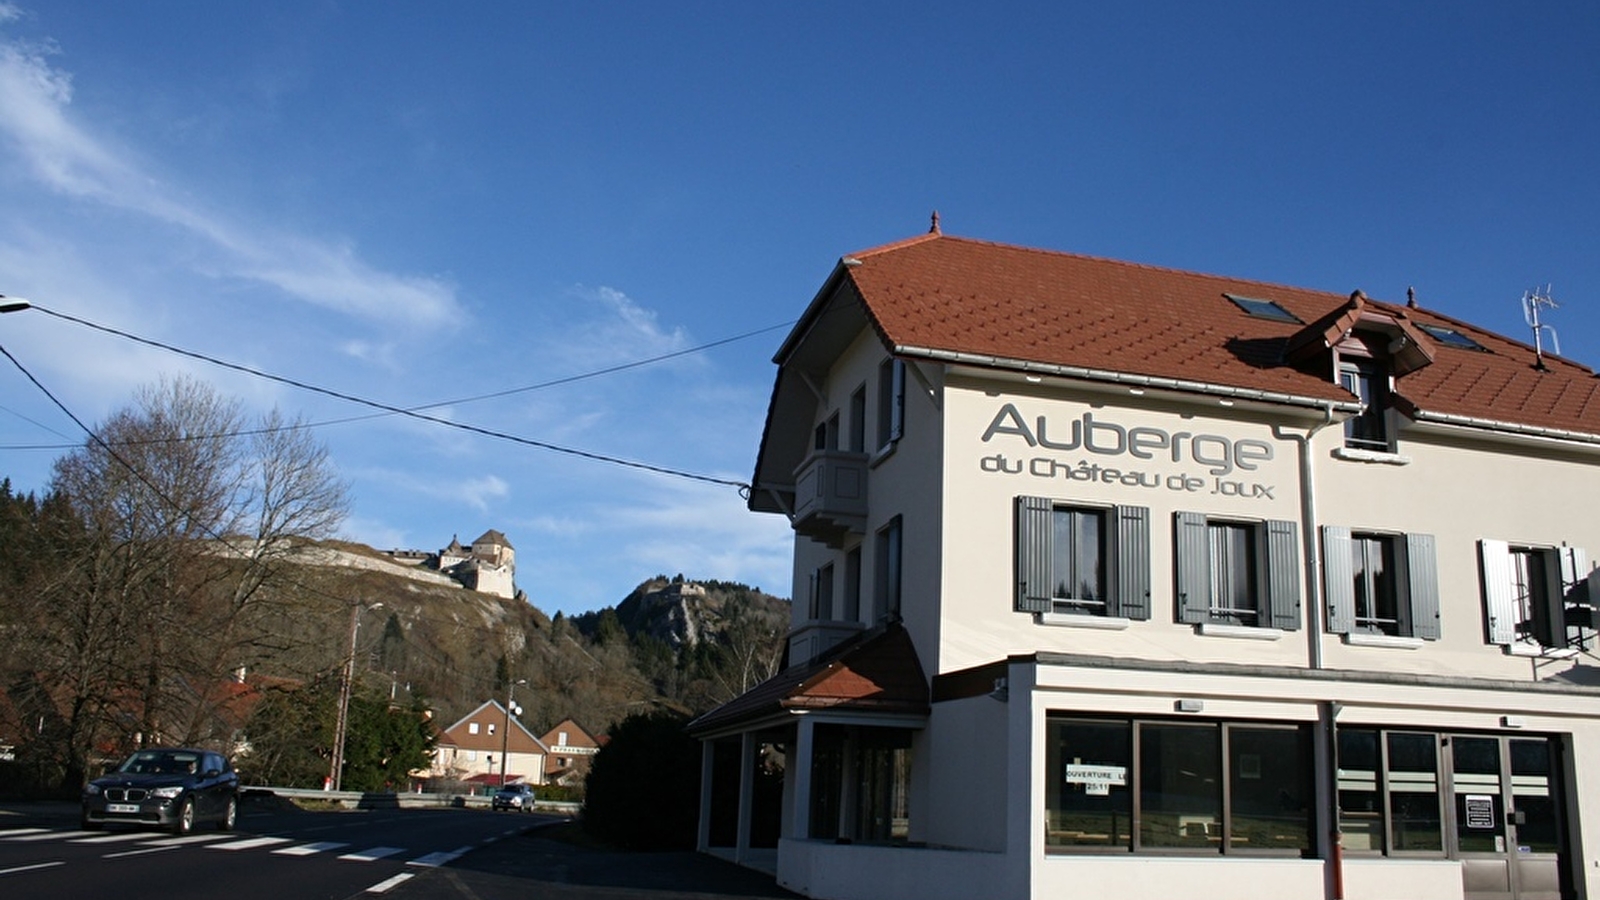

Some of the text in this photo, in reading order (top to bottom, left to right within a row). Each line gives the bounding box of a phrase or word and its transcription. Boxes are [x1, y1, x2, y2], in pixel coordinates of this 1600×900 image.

[981, 403, 1274, 475] Auberge
[980, 454, 1275, 500] du Château de Joux
[1066, 771, 1111, 779] OUVERTURE
